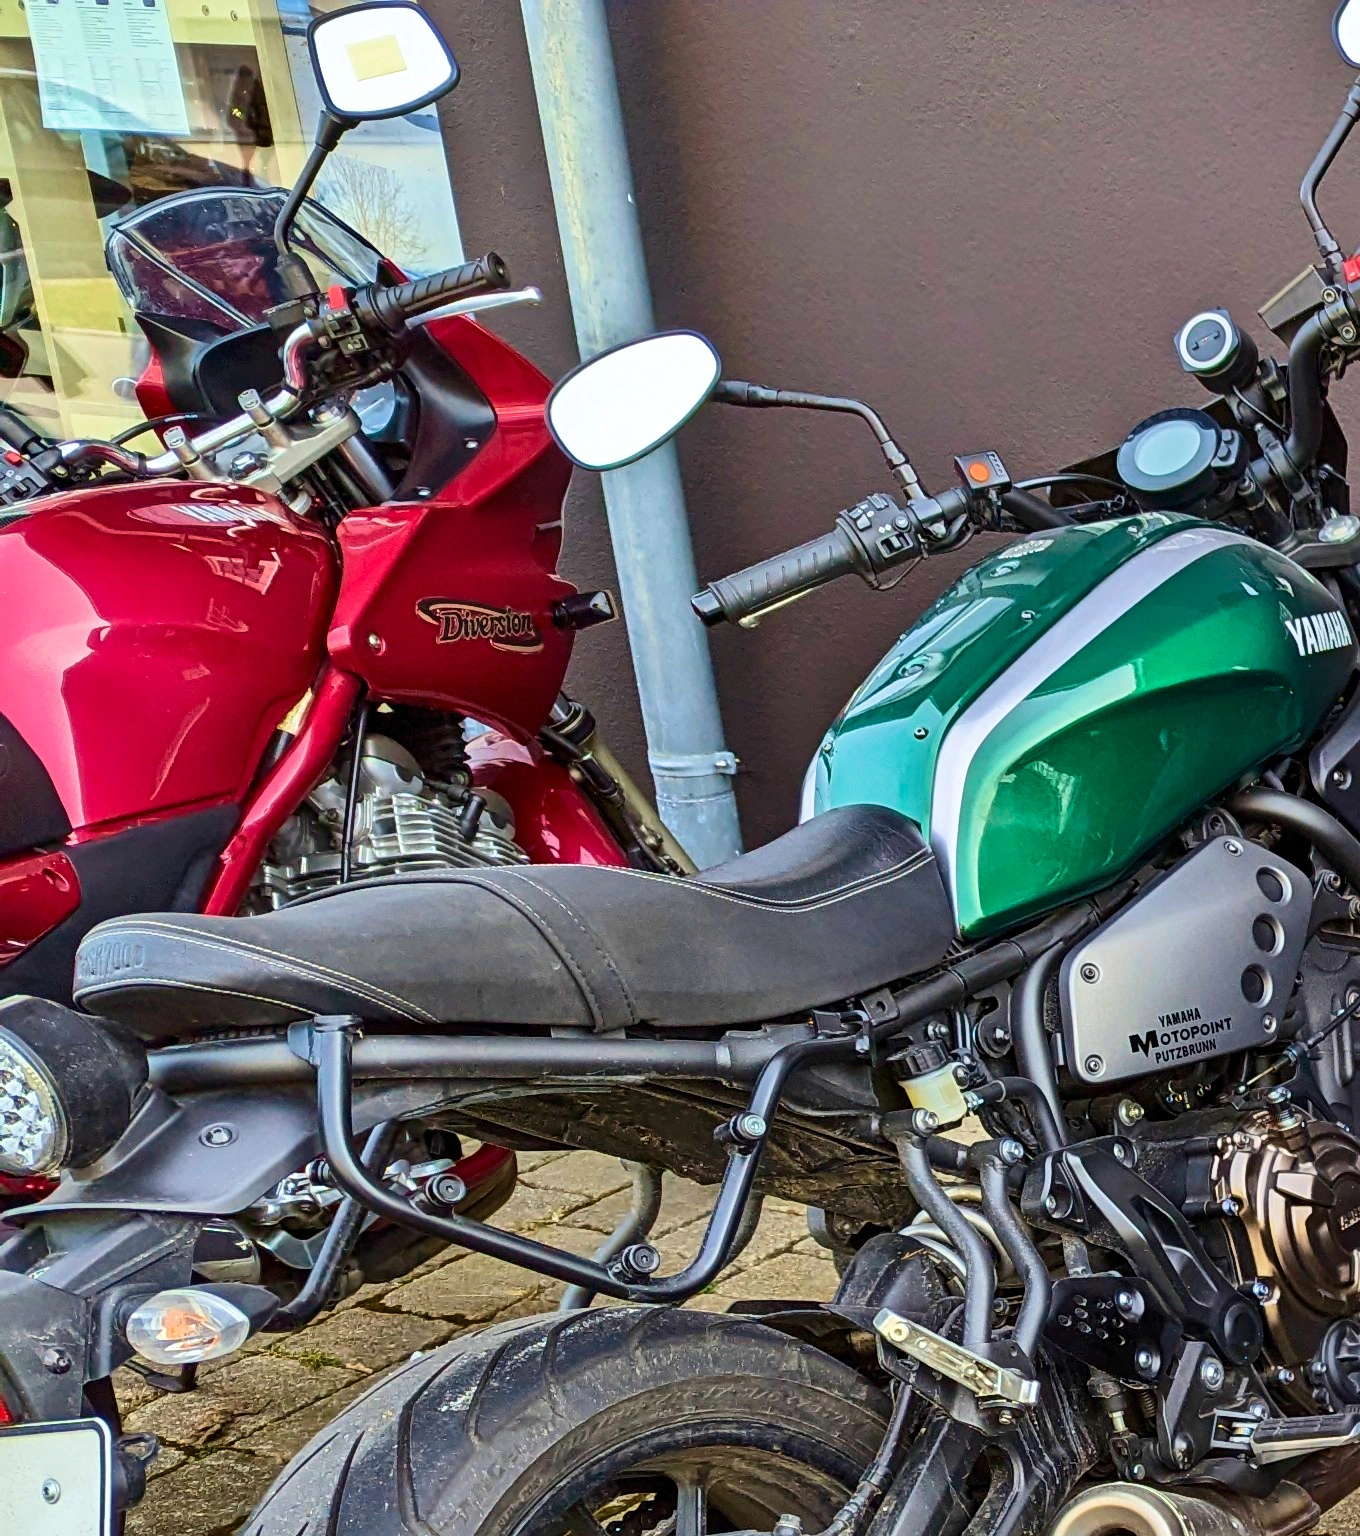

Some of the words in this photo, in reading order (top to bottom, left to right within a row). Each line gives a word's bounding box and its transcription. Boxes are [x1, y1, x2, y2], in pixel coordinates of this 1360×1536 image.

[437, 604, 535, 643] Diversion
[1285, 610, 1353, 656] YAMAHA
[1158, 1007, 1202, 1028] YAMAHA
[1128, 1017, 1232, 1058] MOTOPOINT
[1155, 1038, 1217, 1064] PUTZBRUNN
